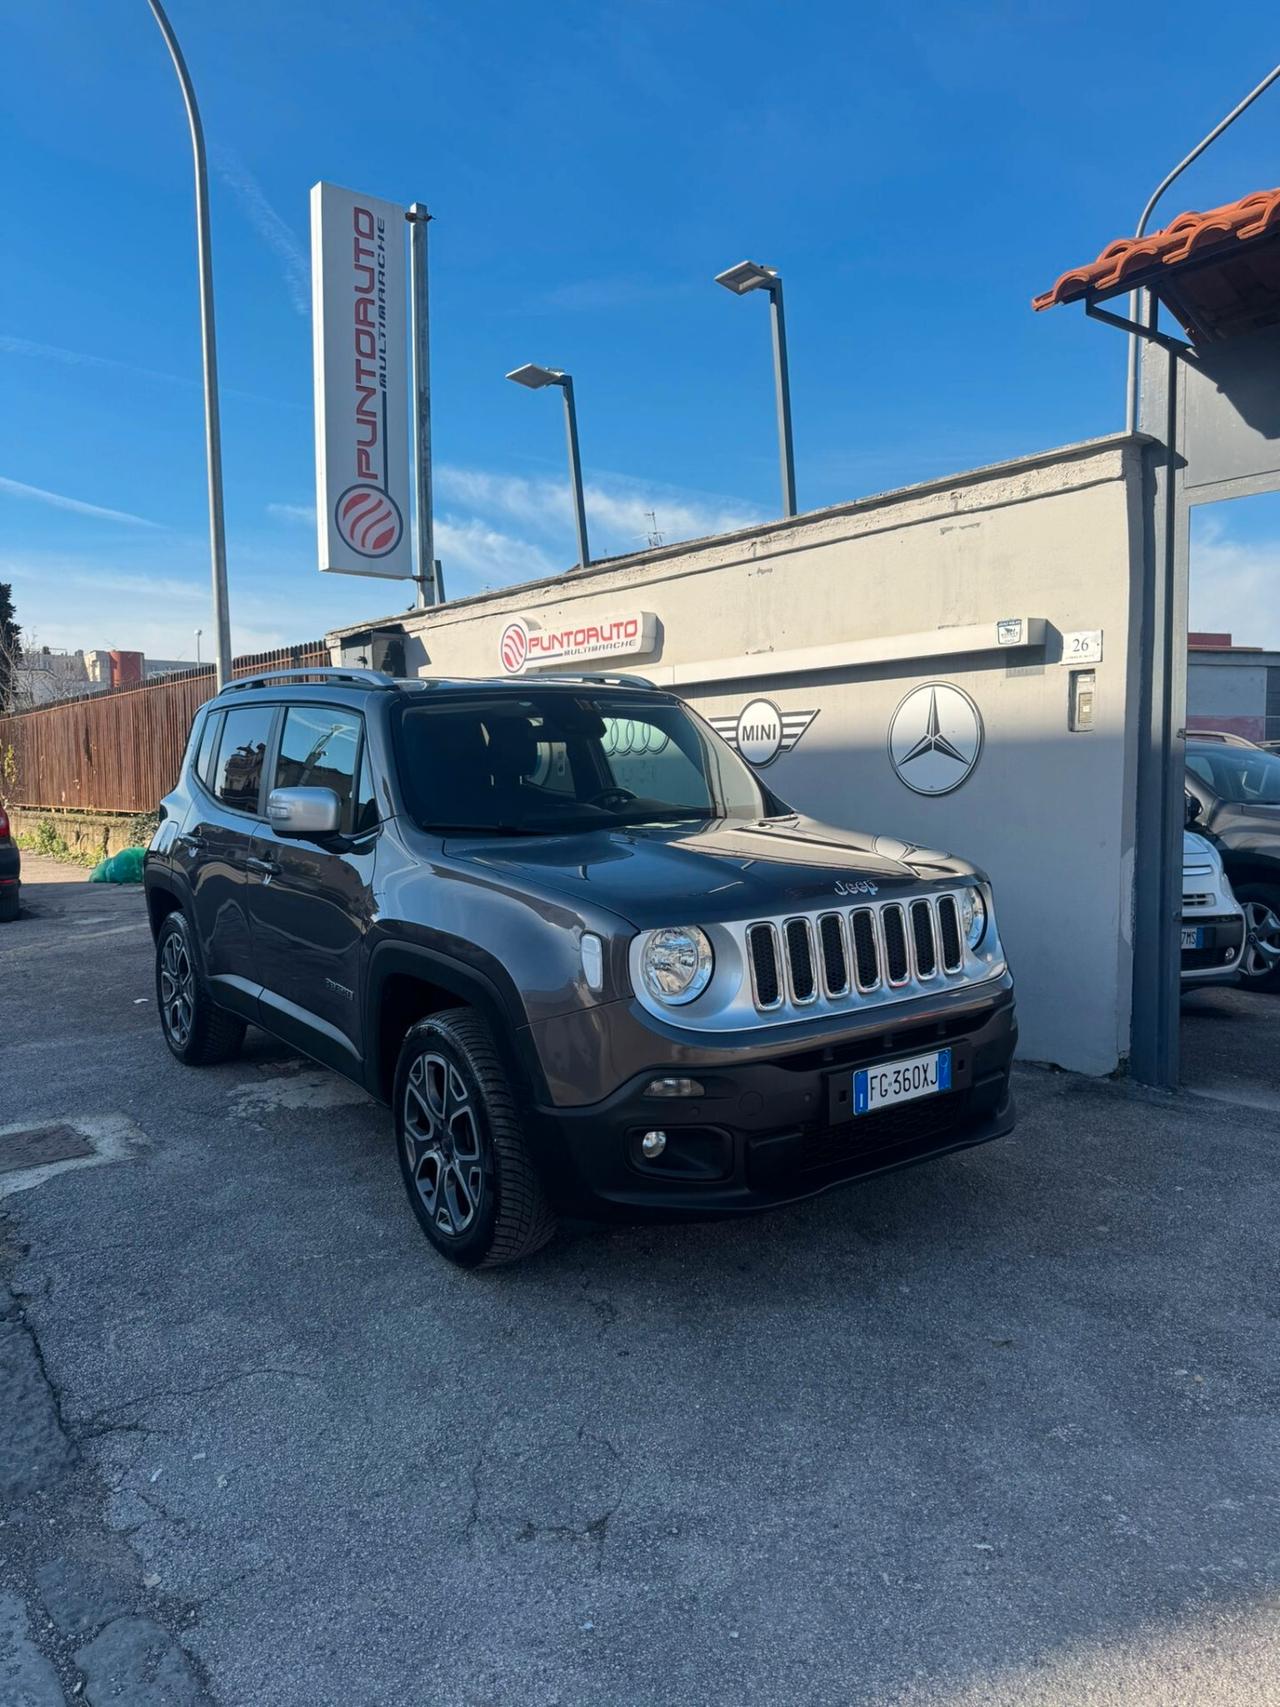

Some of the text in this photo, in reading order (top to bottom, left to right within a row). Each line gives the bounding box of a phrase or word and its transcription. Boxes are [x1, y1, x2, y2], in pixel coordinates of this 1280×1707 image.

[376, 216, 388, 390] MULTIMARCHE
[353, 206, 379, 480] PUNTOAUTO
[528, 619, 638, 654] PUNTOAUTO
[1072, 638, 1089, 652] 26
[563, 639, 637, 657] MULTIMARCHE
[742, 724, 776, 741] MINI
[833, 880, 879, 896] Jeep
